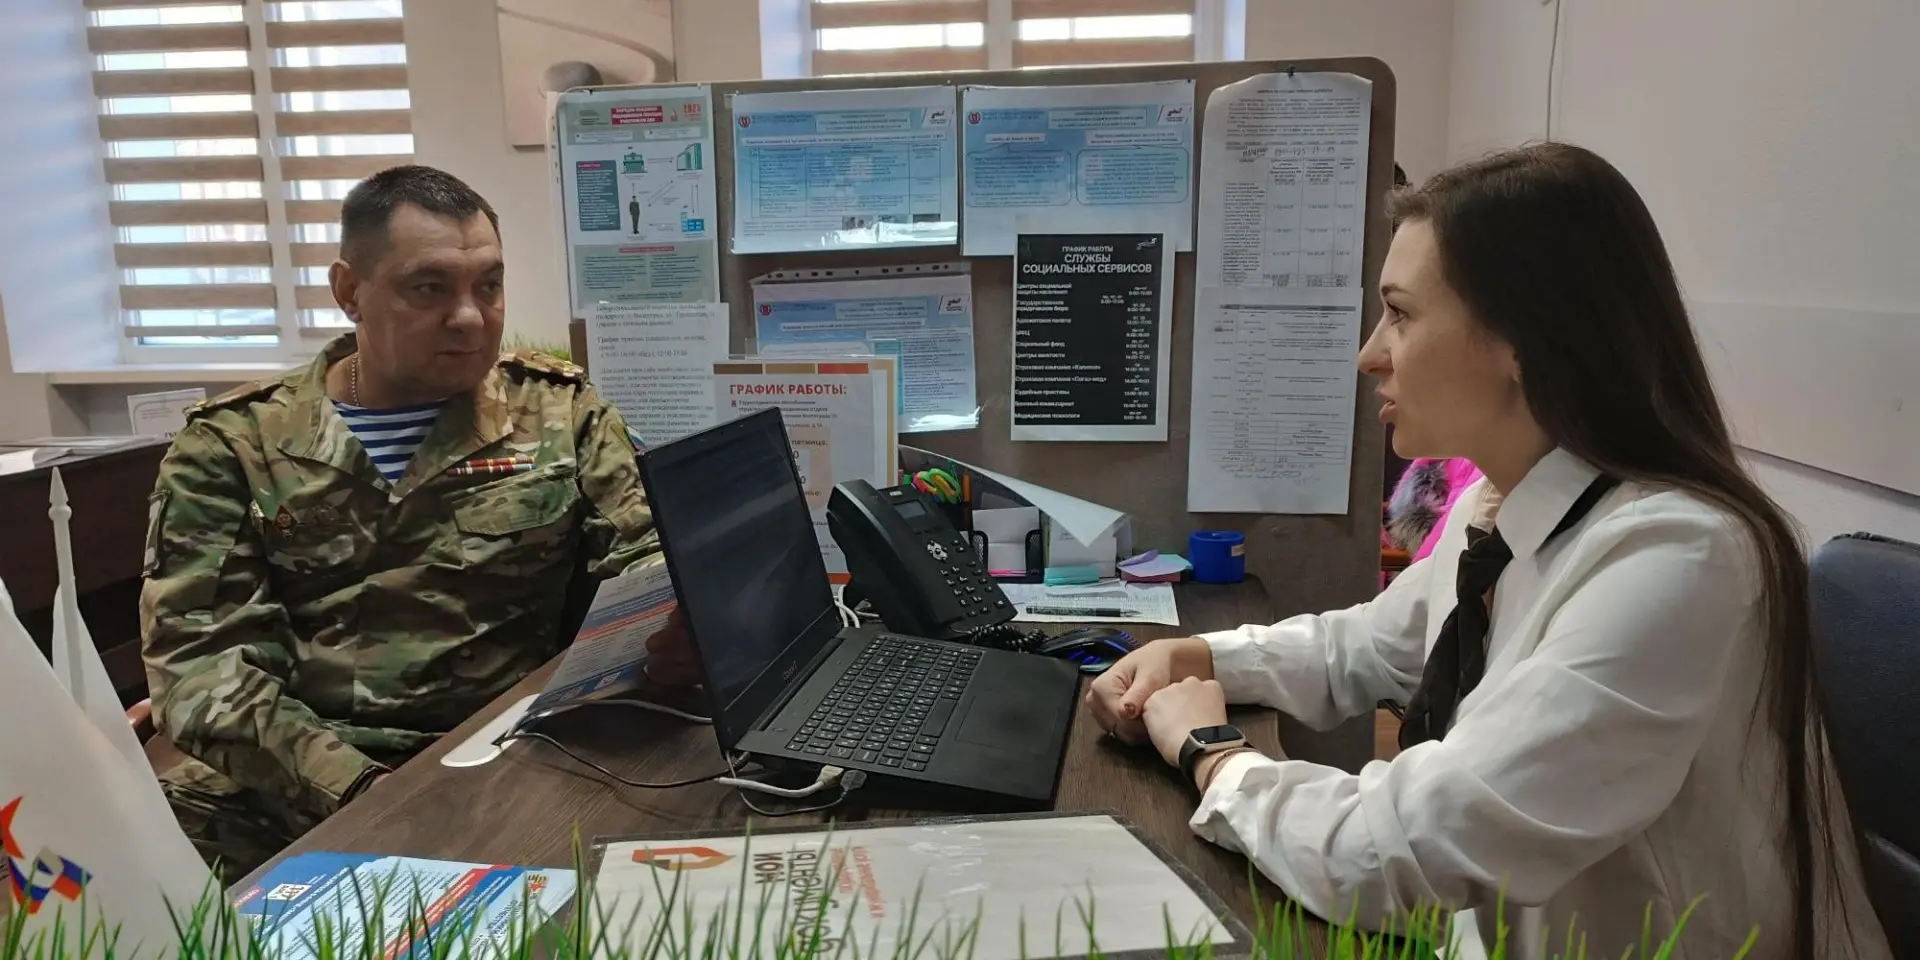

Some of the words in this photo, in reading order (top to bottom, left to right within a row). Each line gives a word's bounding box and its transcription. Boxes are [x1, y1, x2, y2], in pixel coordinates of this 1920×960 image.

[1064, 253, 1111, 263] СЛУЖБЫ
[1022, 264, 1096, 275] СОЦИАЛЬНЫХ
[1097, 263, 1153, 274] СЕРВИСОВ
[730, 384, 785, 395] ГРАФИК
[788, 384, 848, 395] РАБОТЫ:
